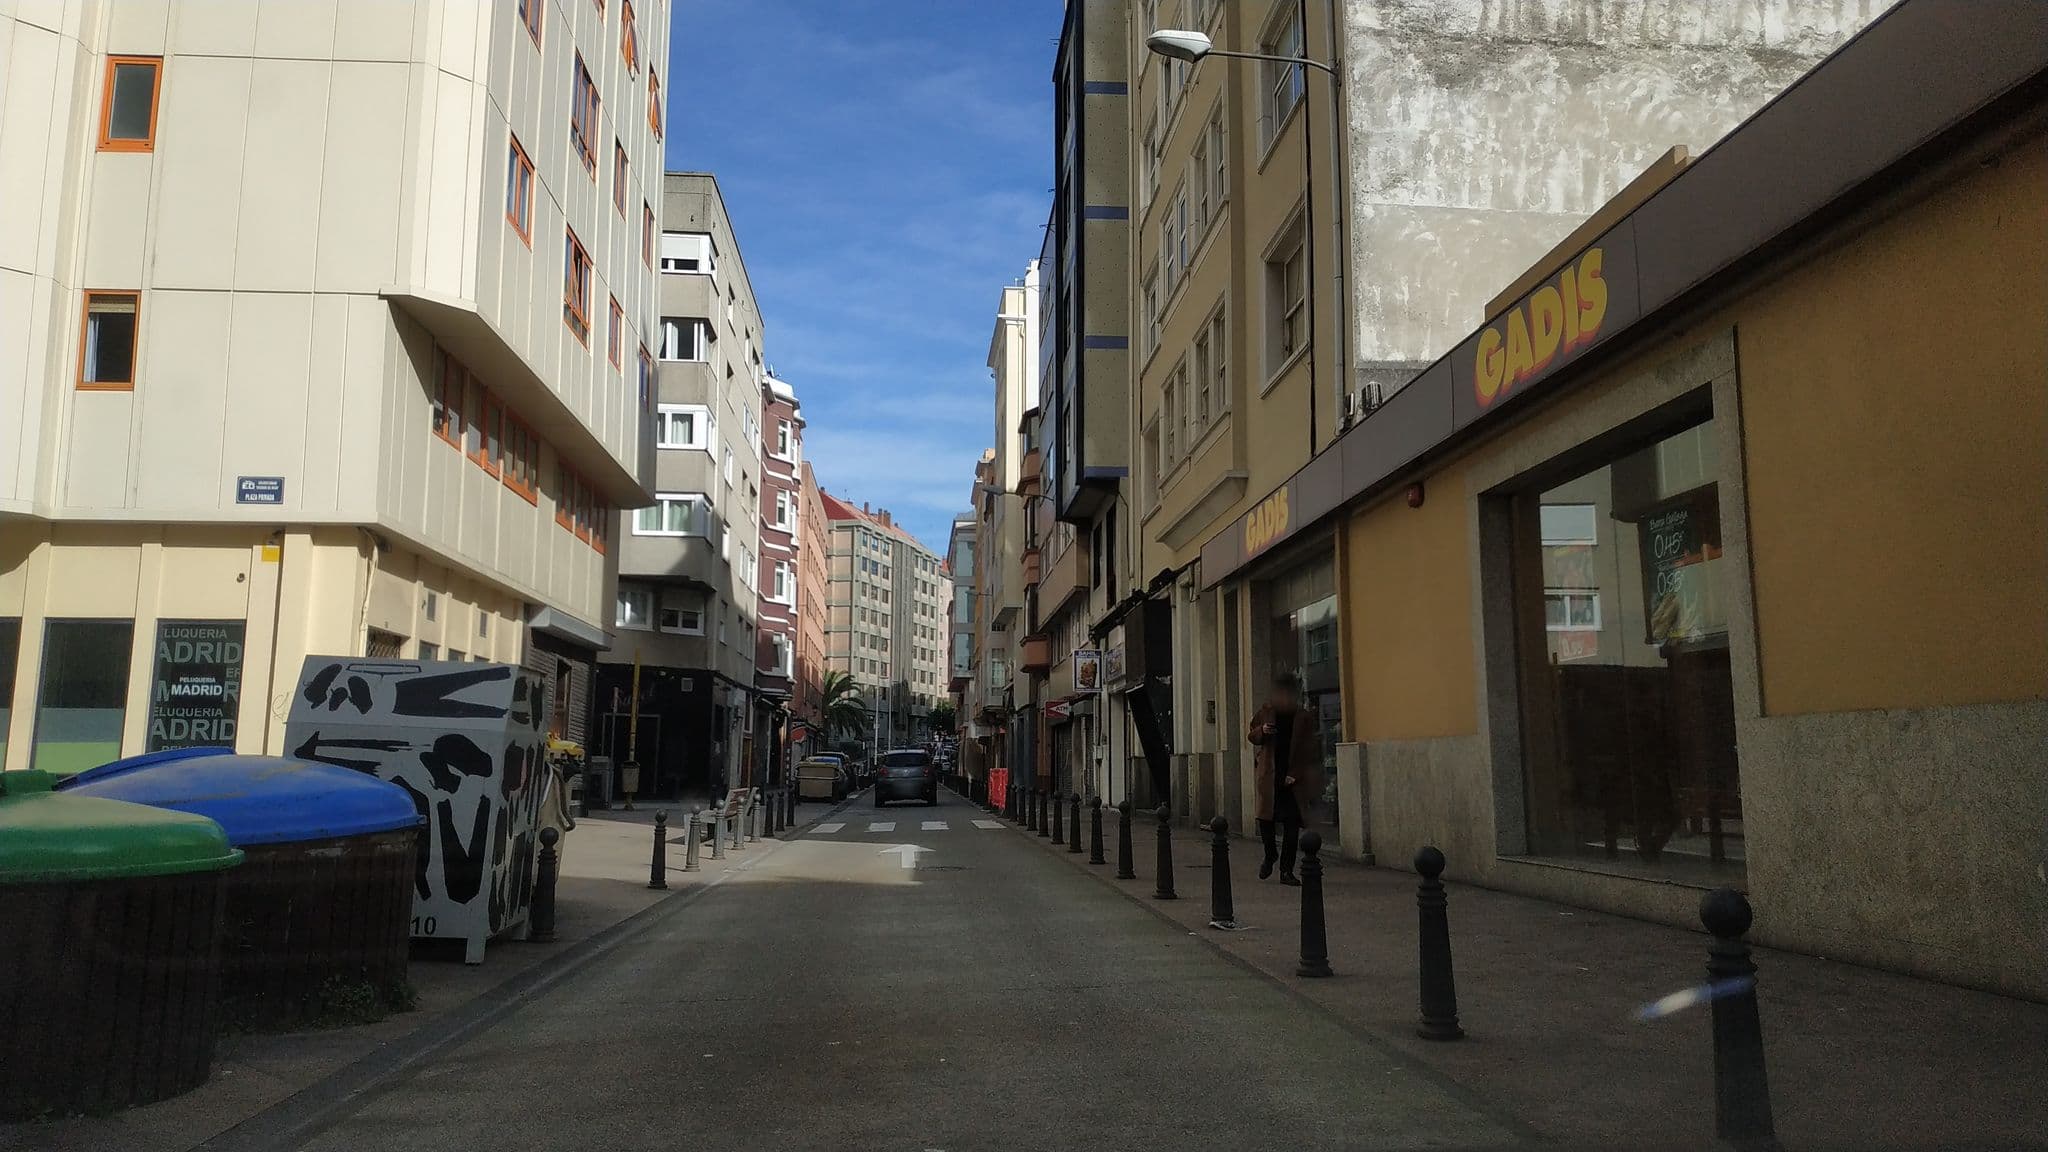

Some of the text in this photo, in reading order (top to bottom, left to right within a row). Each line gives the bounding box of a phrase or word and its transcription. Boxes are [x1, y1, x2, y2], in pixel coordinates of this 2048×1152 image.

[1475, 248, 1607, 400] GADIS
[1246, 486, 1288, 554] GADIS
[171, 684, 222, 696] MADRID
[411, 916, 436, 936] 10
